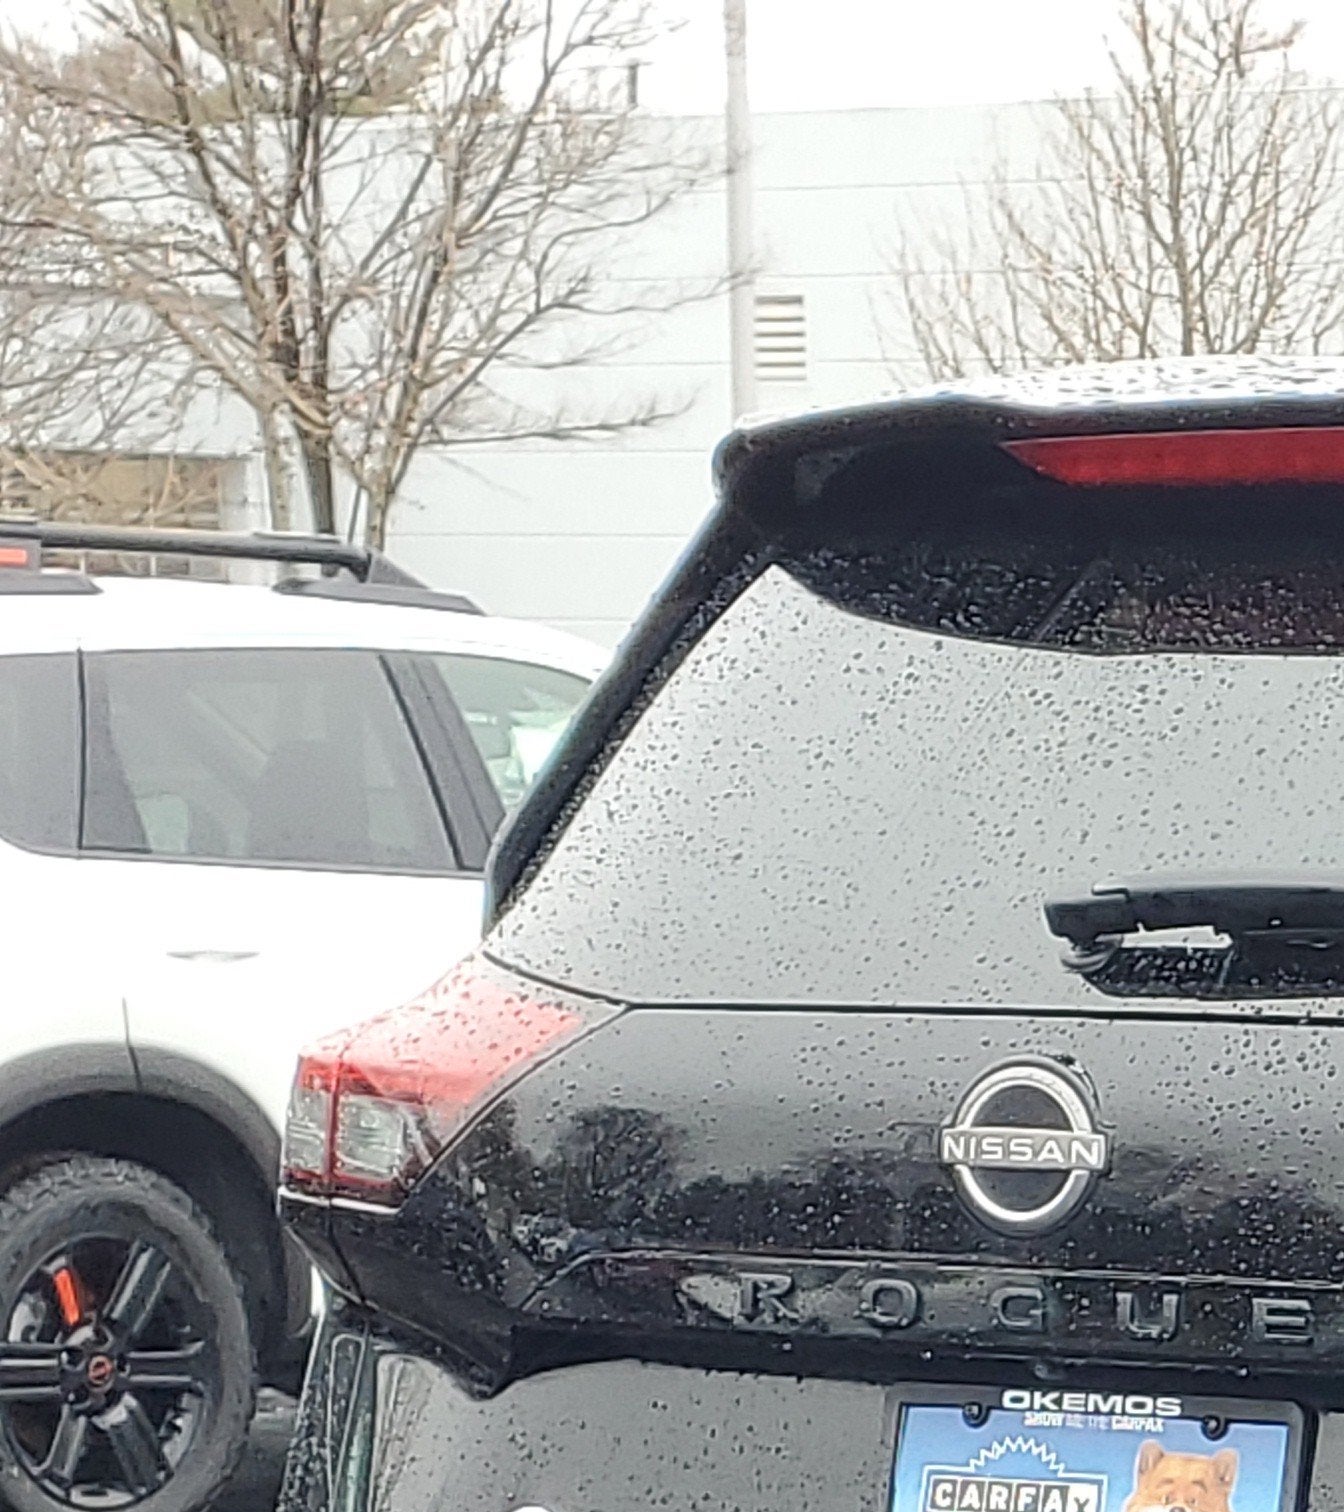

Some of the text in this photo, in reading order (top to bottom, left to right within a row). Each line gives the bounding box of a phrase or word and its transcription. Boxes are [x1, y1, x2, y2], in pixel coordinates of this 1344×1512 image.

[941, 1134, 1101, 1168] NISSAN
[738, 1272, 1315, 1345] ROGUE
[1001, 1388, 1183, 1417] OKEMOS
